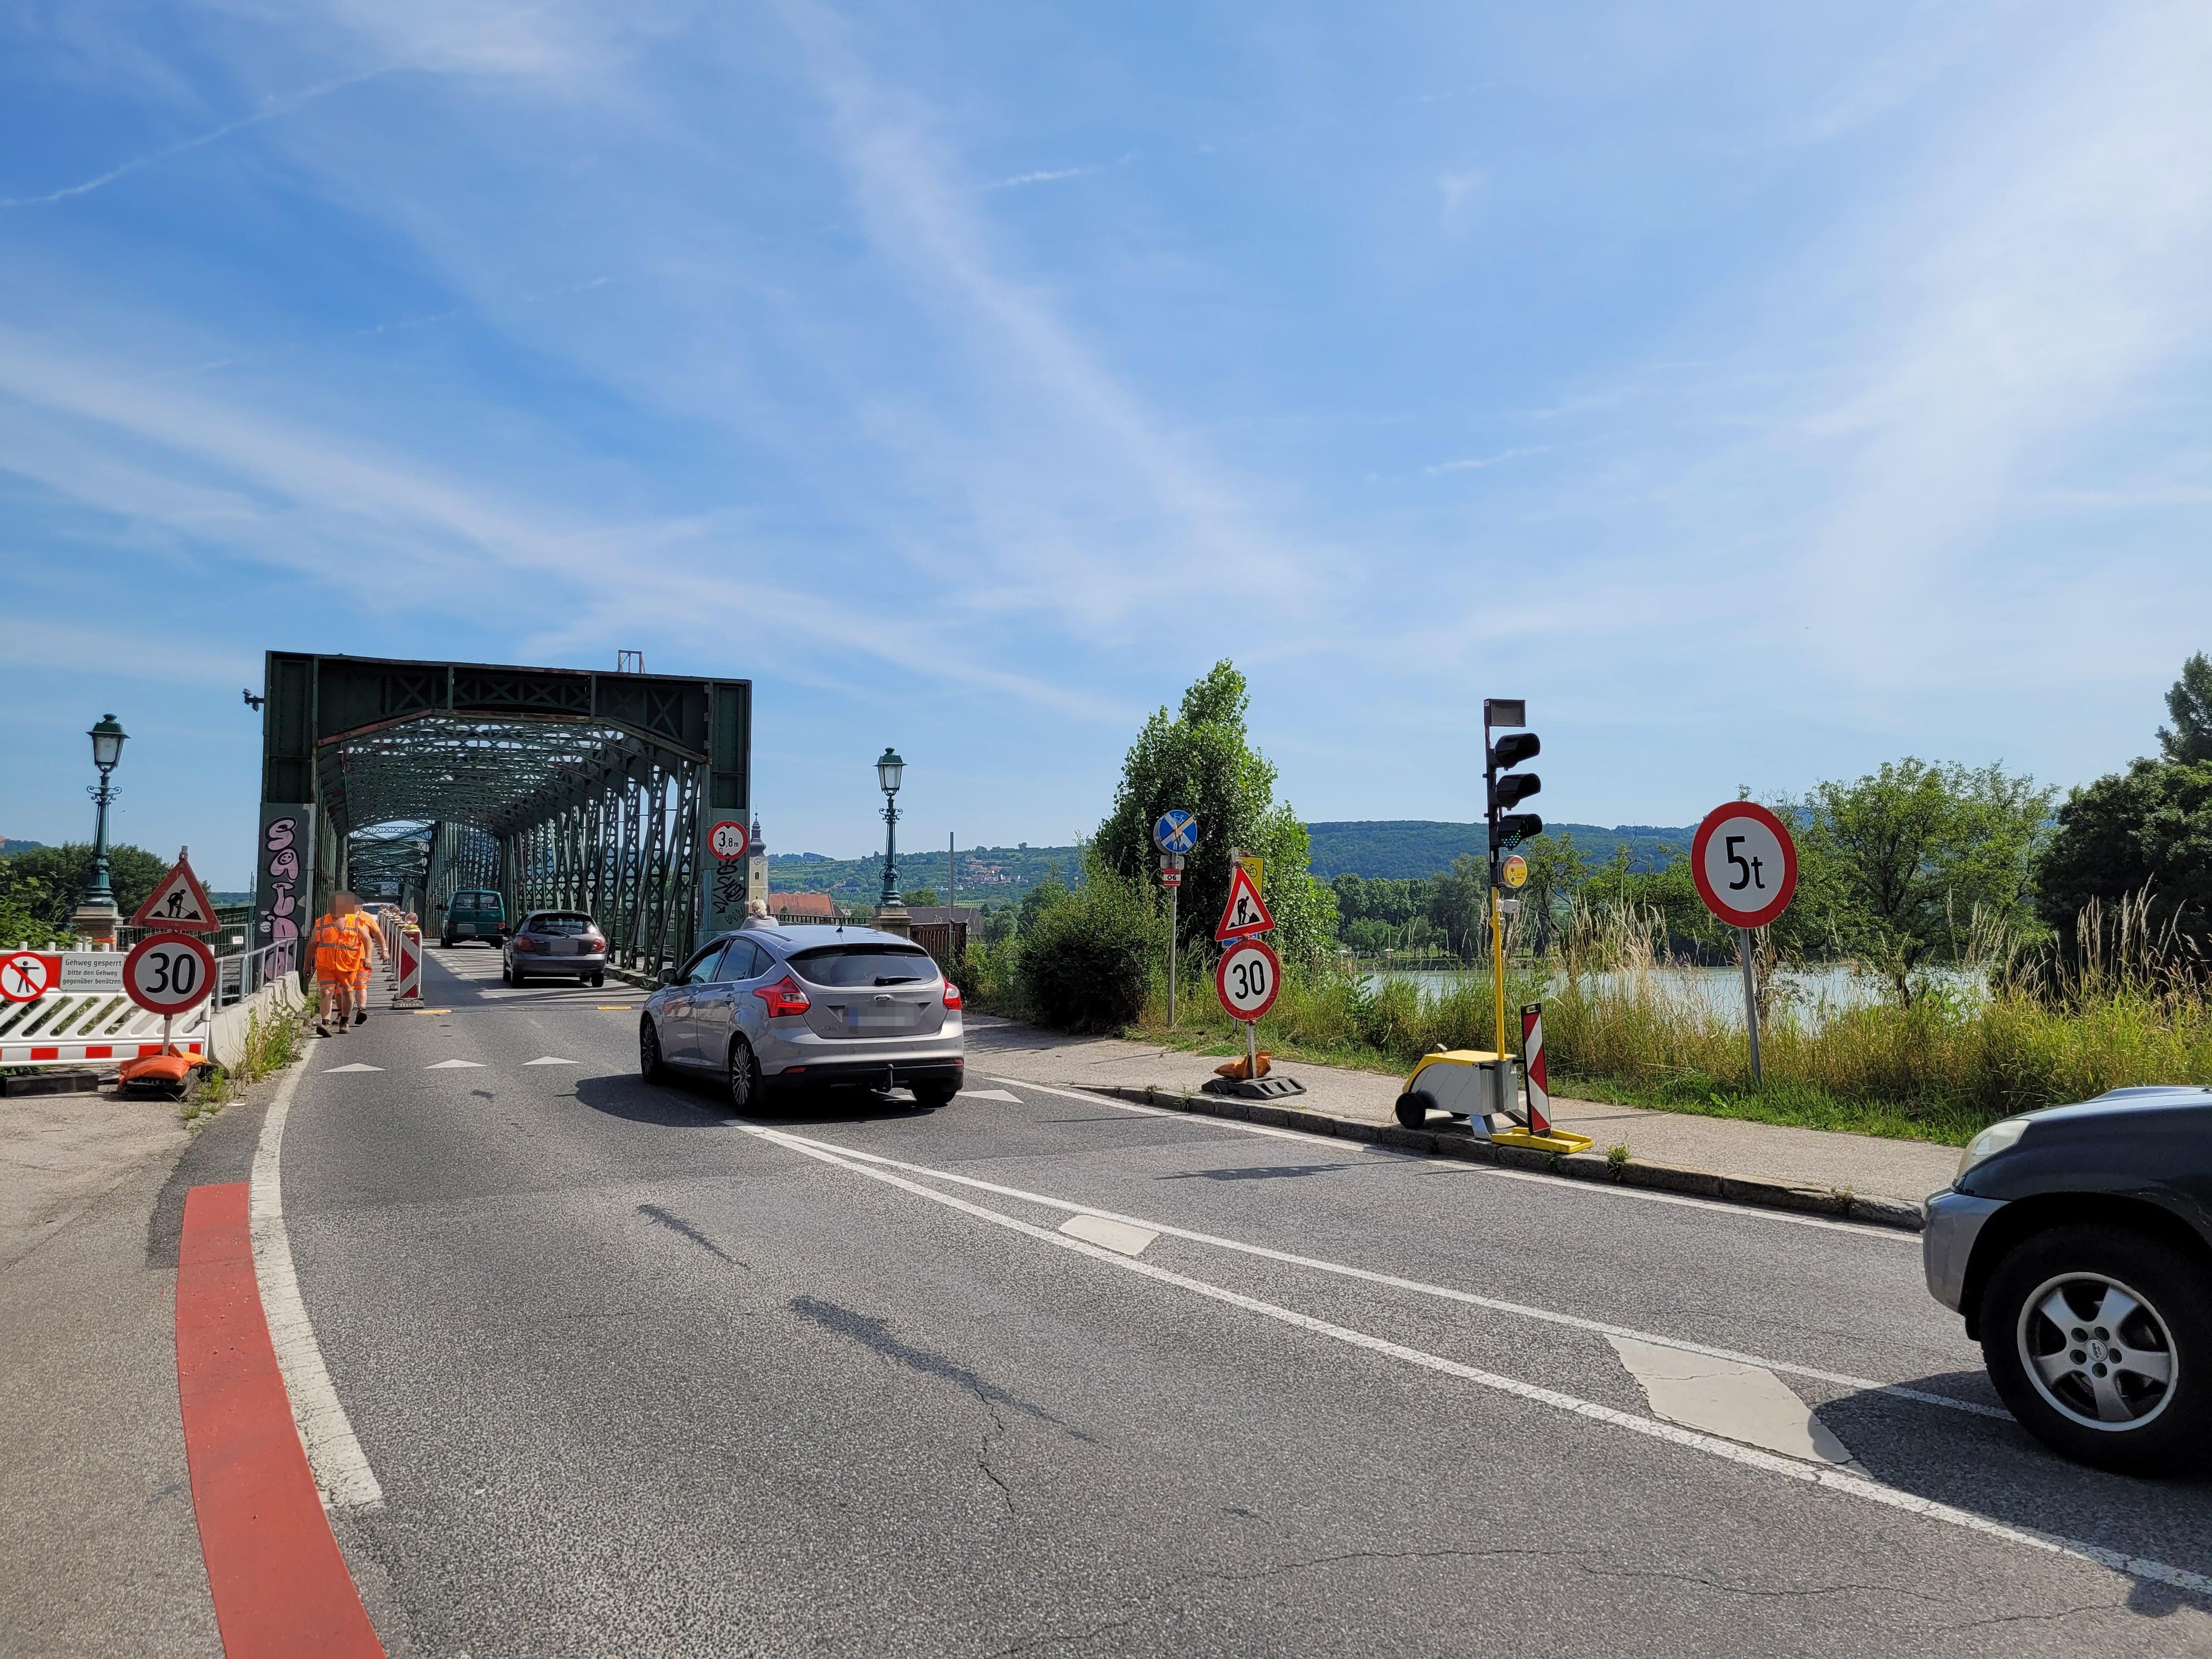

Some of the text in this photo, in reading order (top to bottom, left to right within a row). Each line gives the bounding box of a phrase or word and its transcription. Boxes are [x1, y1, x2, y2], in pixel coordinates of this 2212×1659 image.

[1725, 836, 1766, 890] 5t
[65, 959, 91, 967] Gehweg
[145, 952, 196, 994] 30
[1232, 960, 1265, 1000] 30
